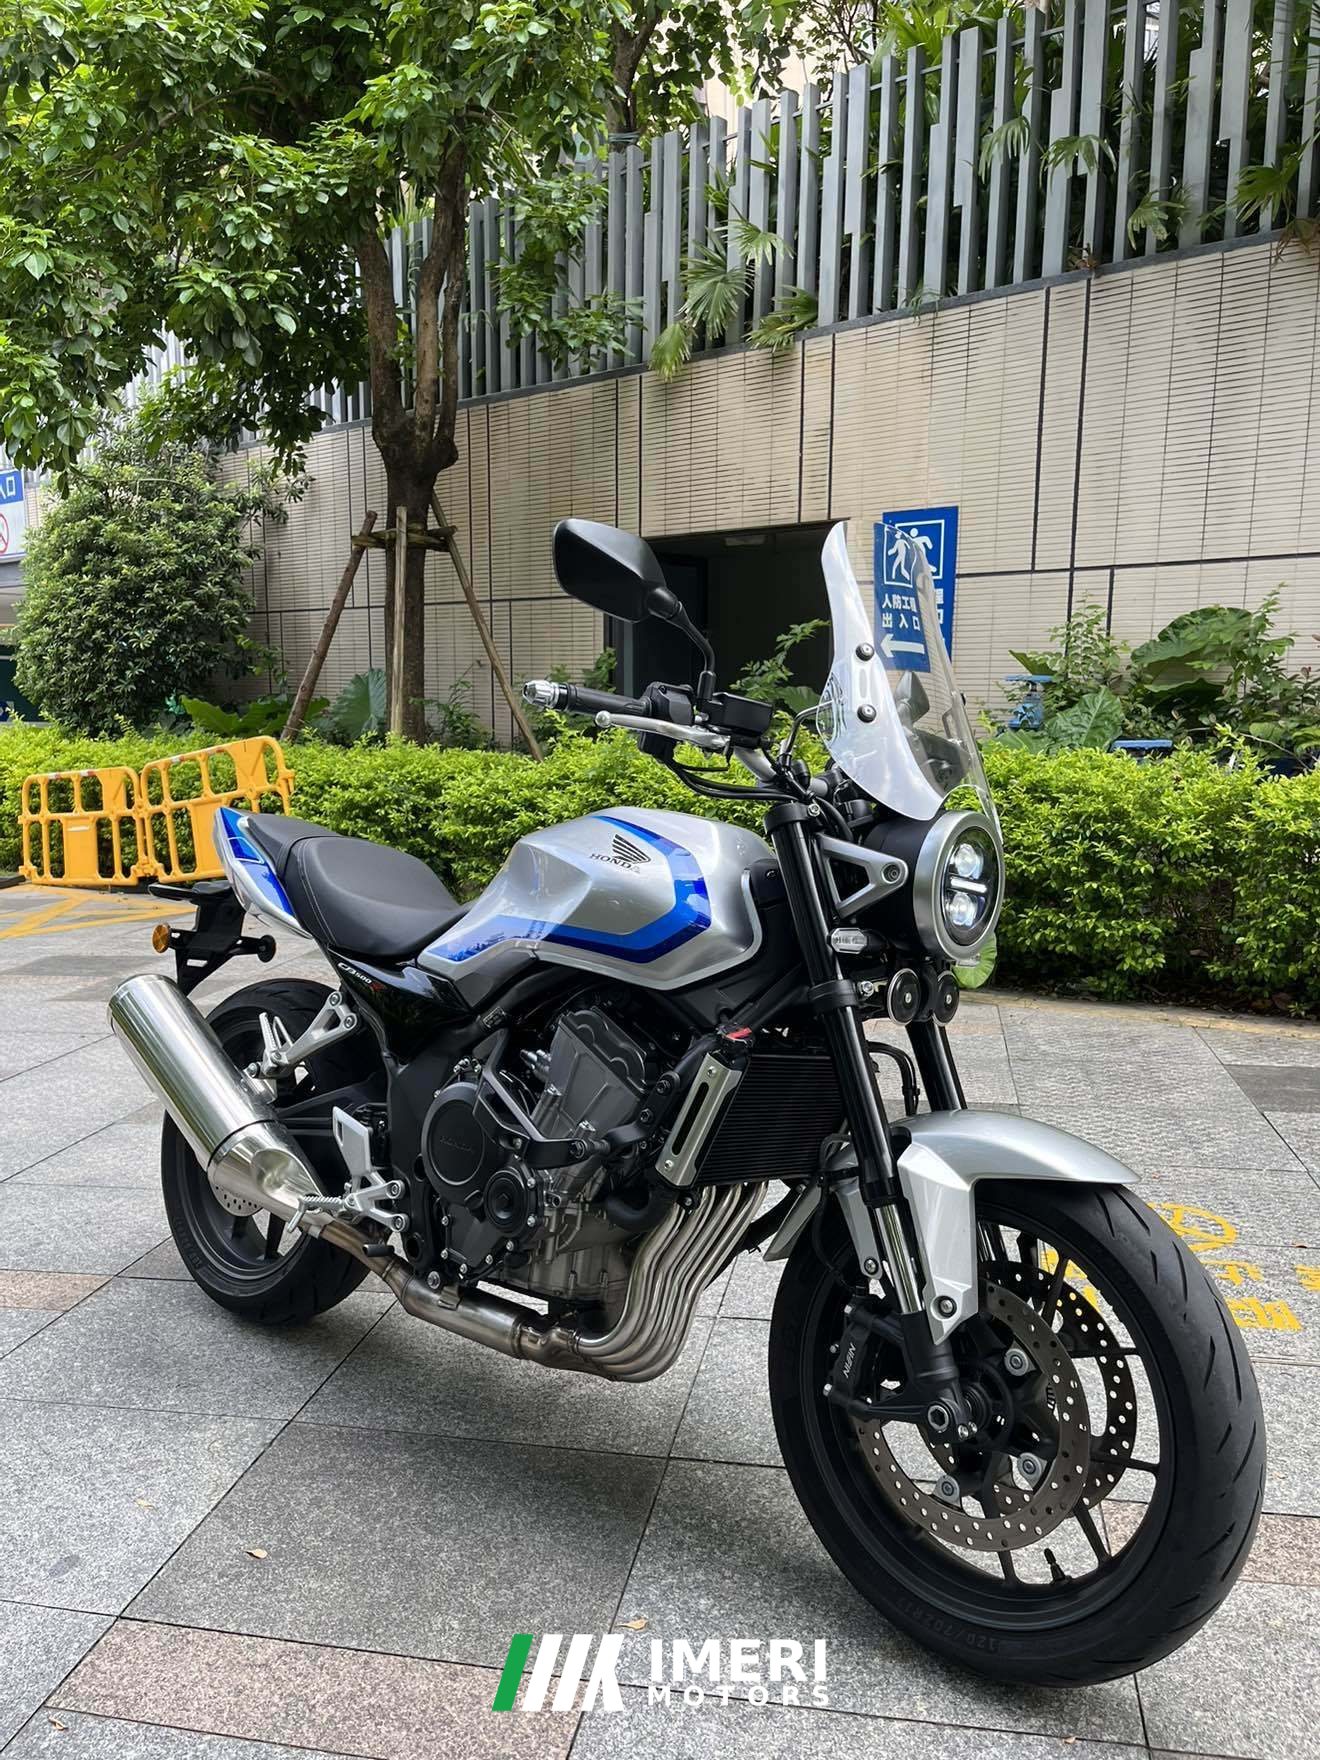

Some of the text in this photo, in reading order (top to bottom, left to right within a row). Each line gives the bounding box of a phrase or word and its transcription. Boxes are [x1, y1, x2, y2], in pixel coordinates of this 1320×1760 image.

[882, 612, 920, 631] 出入口
[590, 853, 641, 873] HONDA
